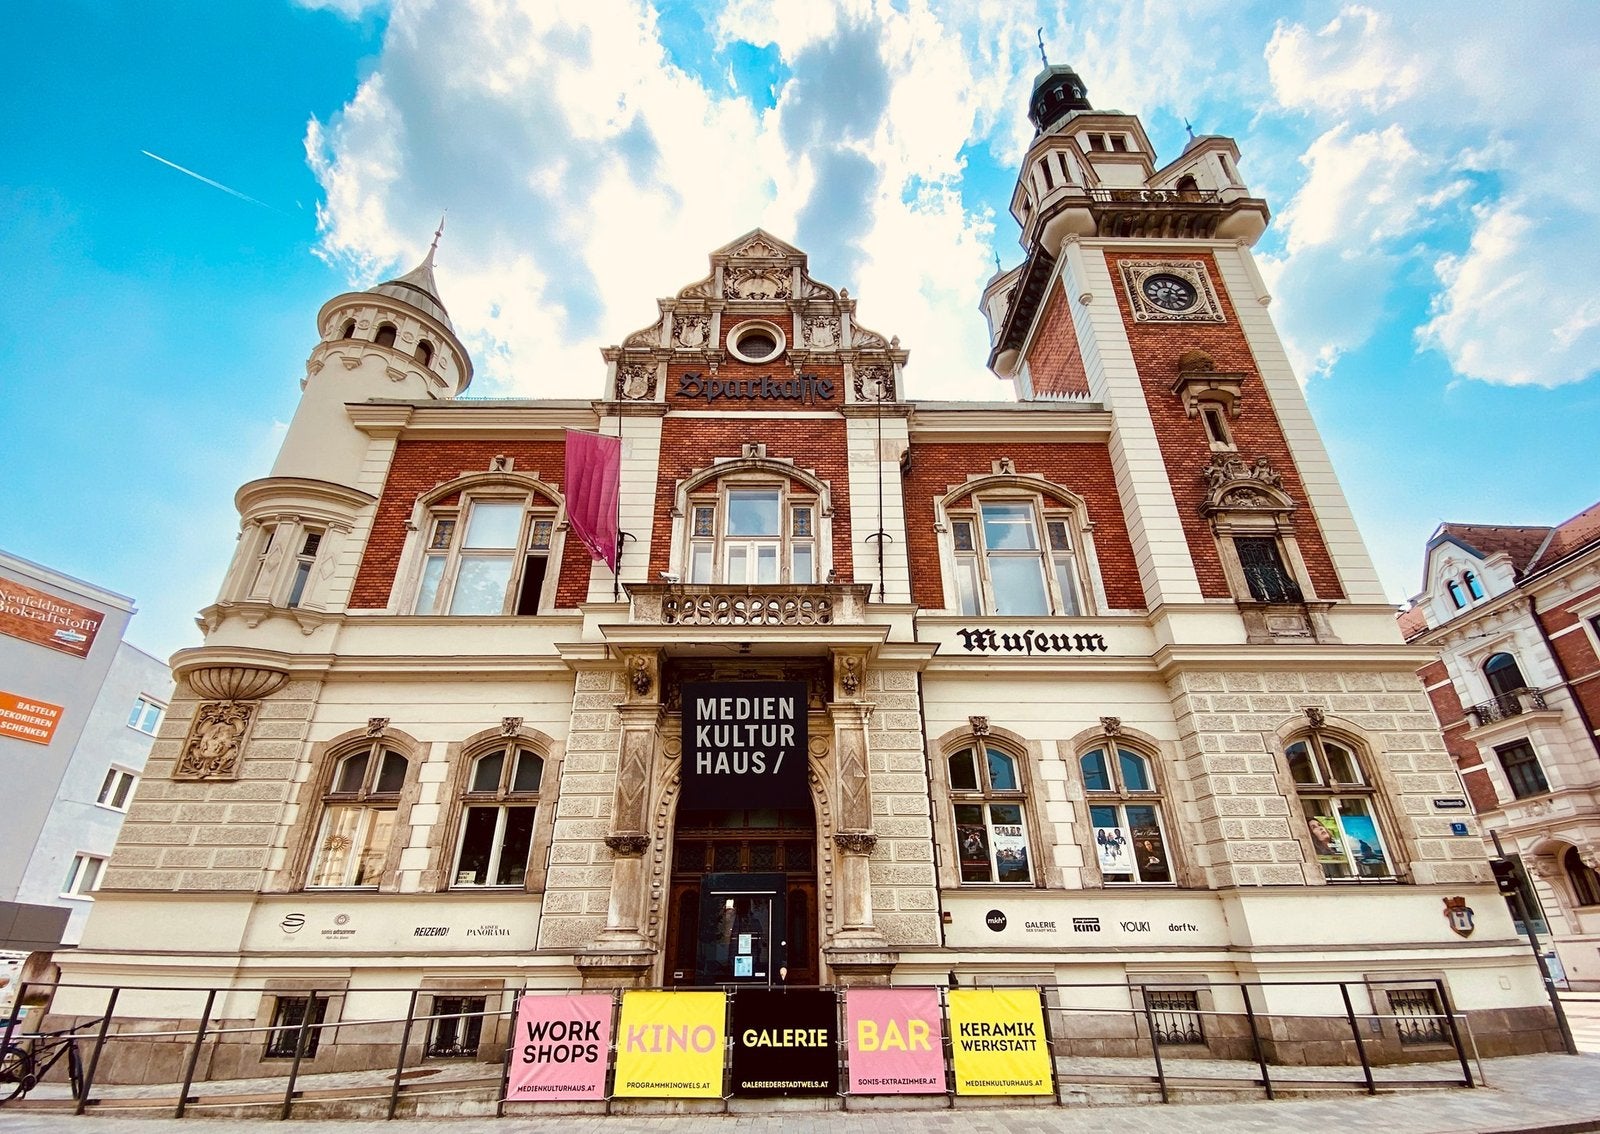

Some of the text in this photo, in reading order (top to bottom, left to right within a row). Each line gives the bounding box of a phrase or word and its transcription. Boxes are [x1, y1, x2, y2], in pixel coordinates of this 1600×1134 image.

[956, 628, 1109, 656] Museum
[16, 701, 57, 718] BASTELN
[696, 697, 795, 720] MEDIEN
[0, 709, 53, 728] DEKORIEREN
[0, 721, 49, 738] SCHENKEN
[696, 724, 796, 747] KULTUR
[696, 751, 767, 775] HAUS
[465, 928, 511, 936] PANORAMA
[1024, 921, 1057, 929] GALERIE
[1119, 921, 1152, 932] YOUKI
[527, 1019, 602, 1042] WORK
[742, 1028, 829, 1048] GALERIE
[856, 1019, 932, 1052] BAR
[959, 1022, 1036, 1037] KERAMIK
[626, 1024, 717, 1054] KINO
[962, 1039, 1037, 1052] WERKSTATT
[522, 1044, 599, 1064] SHOPS
[517, 1084, 597, 1093] MEDIENKULTURHAUS.AT
[625, 1081, 711, 1090] PROGRAMMKINOWELS.AT
[740, 1081, 829, 1089] GALERIEDERSTADTWELS.AT
[857, 1077, 938, 1086] SONIS-EXTRAZIMMER.AT
[964, 1079, 1044, 1088] MEDIENKULTURHAUS.AT
